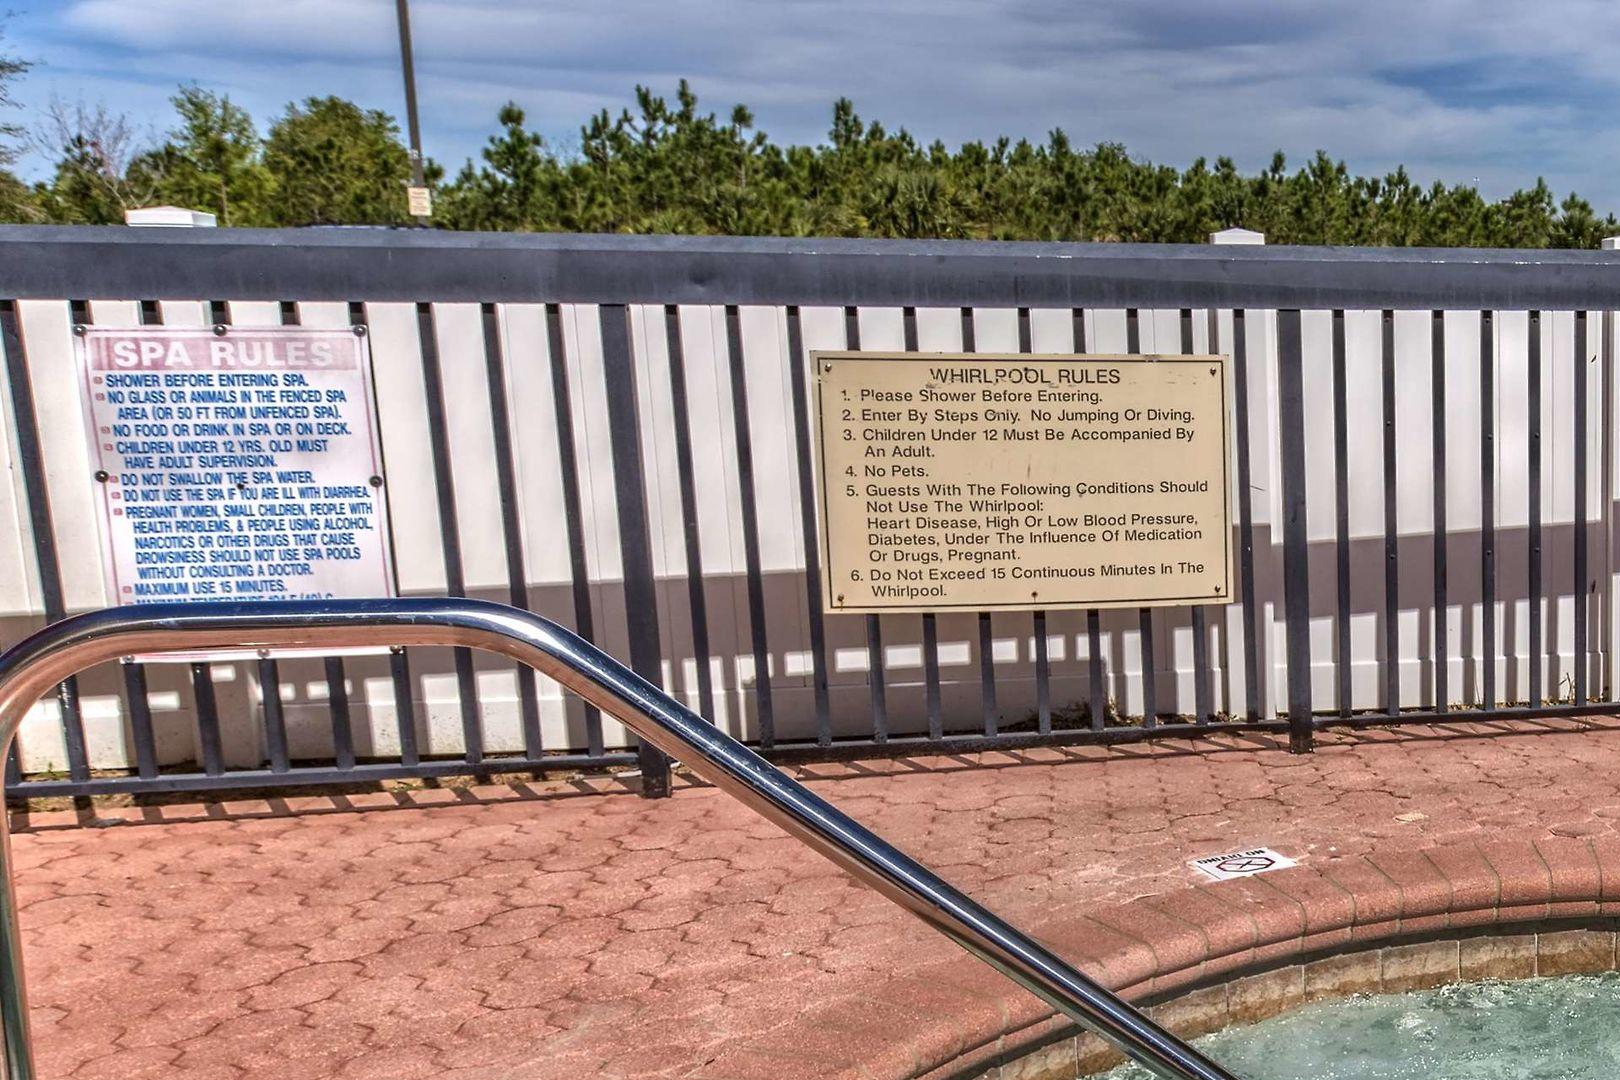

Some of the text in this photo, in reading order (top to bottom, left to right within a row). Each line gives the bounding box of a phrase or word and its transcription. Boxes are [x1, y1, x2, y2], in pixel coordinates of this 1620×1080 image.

[113, 340, 335, 367] SPA RULES
[105, 374, 308, 388] SHOWER BEFORE ENTERING SPA.
[929, 366, 1121, 387] WHIRLPOOL RULES
[107, 390, 346, 404] NO GLASS OR ANIMALS IN THE FENCED SPA
[860, 388, 914, 403] Please
[918, 387, 977, 403] Shower
[981, 388, 1033, 405] Before
[1036, 388, 1103, 406] Entering.
[118, 406, 341, 421] AREA (OR 50 FT FROM UNFENCED SPA).
[841, 408, 1196, 425] 2. Enter By Steps Only. No Jumping Or Diving.
[113, 423, 351, 437] NO FOOD OR DRINK IN SPA OR ON DECK.
[842, 425, 1195, 443] 3. Children Under 12 Must Be Accompanied By
[116, 440, 327, 455] CHILDREN UNDER 12 YRS. OLD MUST
[863, 444, 936, 458] An Adult.
[125, 455, 277, 469] HAVE ADULT SUPERVISION.
[121, 471, 315, 486] DO NOT SWALLOW THE SPA WATER.
[844, 464, 930, 478] 4. No Pets.
[845, 480, 1209, 498] 5. Guests With The Following Conditions Should
[126, 503, 372, 519] PREGNANT WOMEN, SMALL CHILDREN, PEOPLE WITH
[866, 498, 1044, 515] Not Use The Whirlpool:
[133, 518, 372, 534] HEALTH PROBLEMS, & PEOPLE USING ALCOHOL,
[866, 512, 1199, 532] Heart Disease, High Or Low Blood Pressure,
[135, 533, 355, 549] NARCOTICS OR OTHER DRUGS THAT CAUSE
[867, 527, 1203, 548] Diabetes, Under The Influence Of Medication
[868, 547, 1021, 565] Or Drugs, Pregnant.
[137, 563, 313, 580] WITHOUT CONSULTING A DOCTOR.
[850, 561, 1205, 582] 6. Do Not Exceed 15 Continuous Minutes In The
[135, 580, 287, 596] MAXIMUM USE 15 MINUTES.
[870, 583, 948, 600] Whirlpool.
